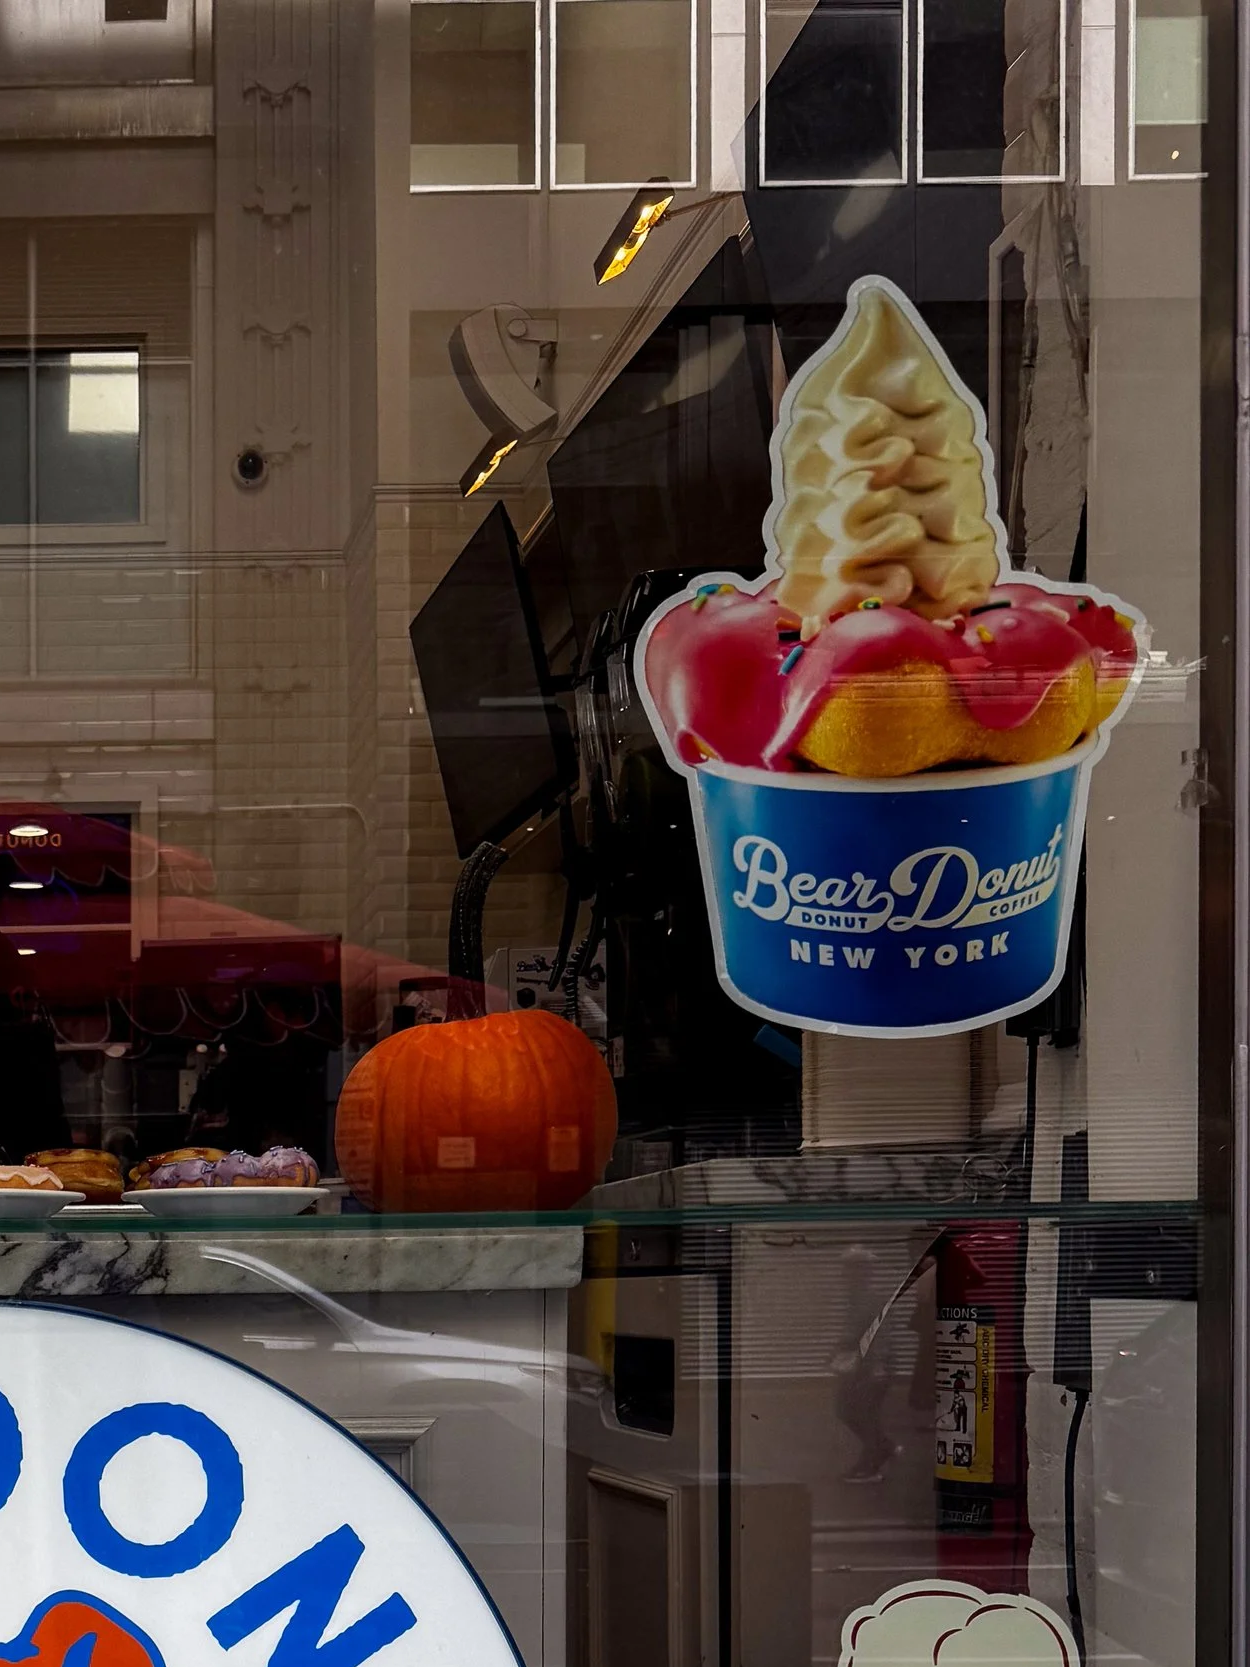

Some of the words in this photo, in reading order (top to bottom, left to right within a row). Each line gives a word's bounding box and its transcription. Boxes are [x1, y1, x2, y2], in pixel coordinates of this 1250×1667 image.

[733, 835, 893, 922] Bear
[887, 824, 1062, 932] Donut
[801, 911, 868, 930] DONUT
[989, 891, 1041, 918] COFFEE
[790, 938, 875, 969] NEW
[904, 931, 1009, 969] YORK
